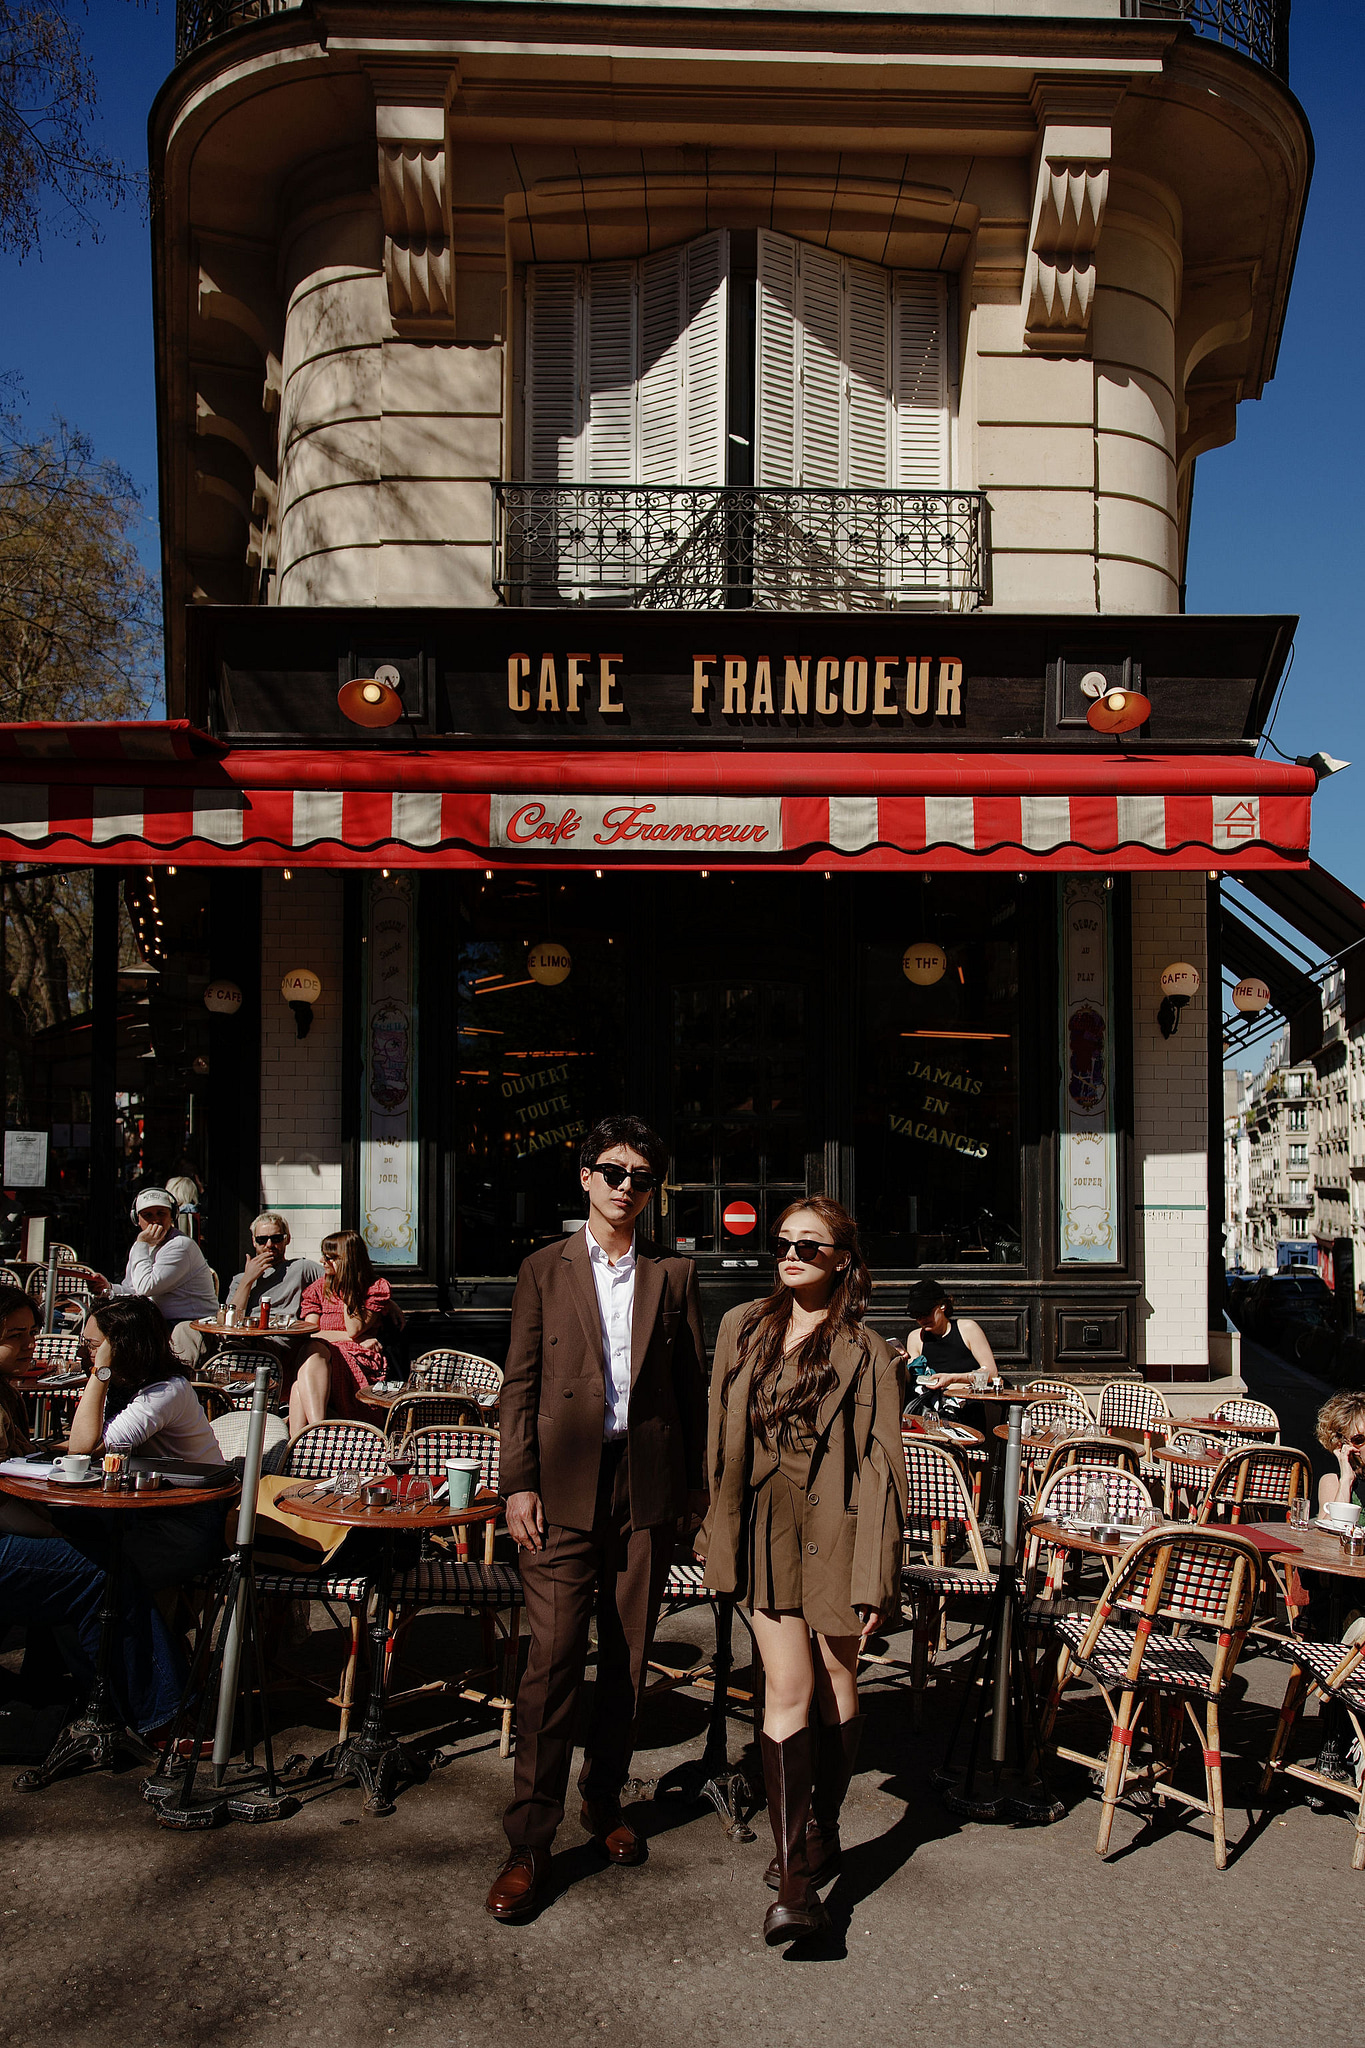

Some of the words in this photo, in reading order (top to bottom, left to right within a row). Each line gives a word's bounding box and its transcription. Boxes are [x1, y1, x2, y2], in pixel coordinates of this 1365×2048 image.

[507, 652, 624, 713] CAFE
[692, 653, 964, 716] FRANCOEUR
[506, 803, 583, 849] Café
[501, 1063, 569, 1099] OUVERT
[907, 1061, 984, 1096] JAMAIS
[515, 1094, 571, 1123] TOUTE
[921, 1096, 950, 1116] EN
[888, 1113, 990, 1159] VACANCES
